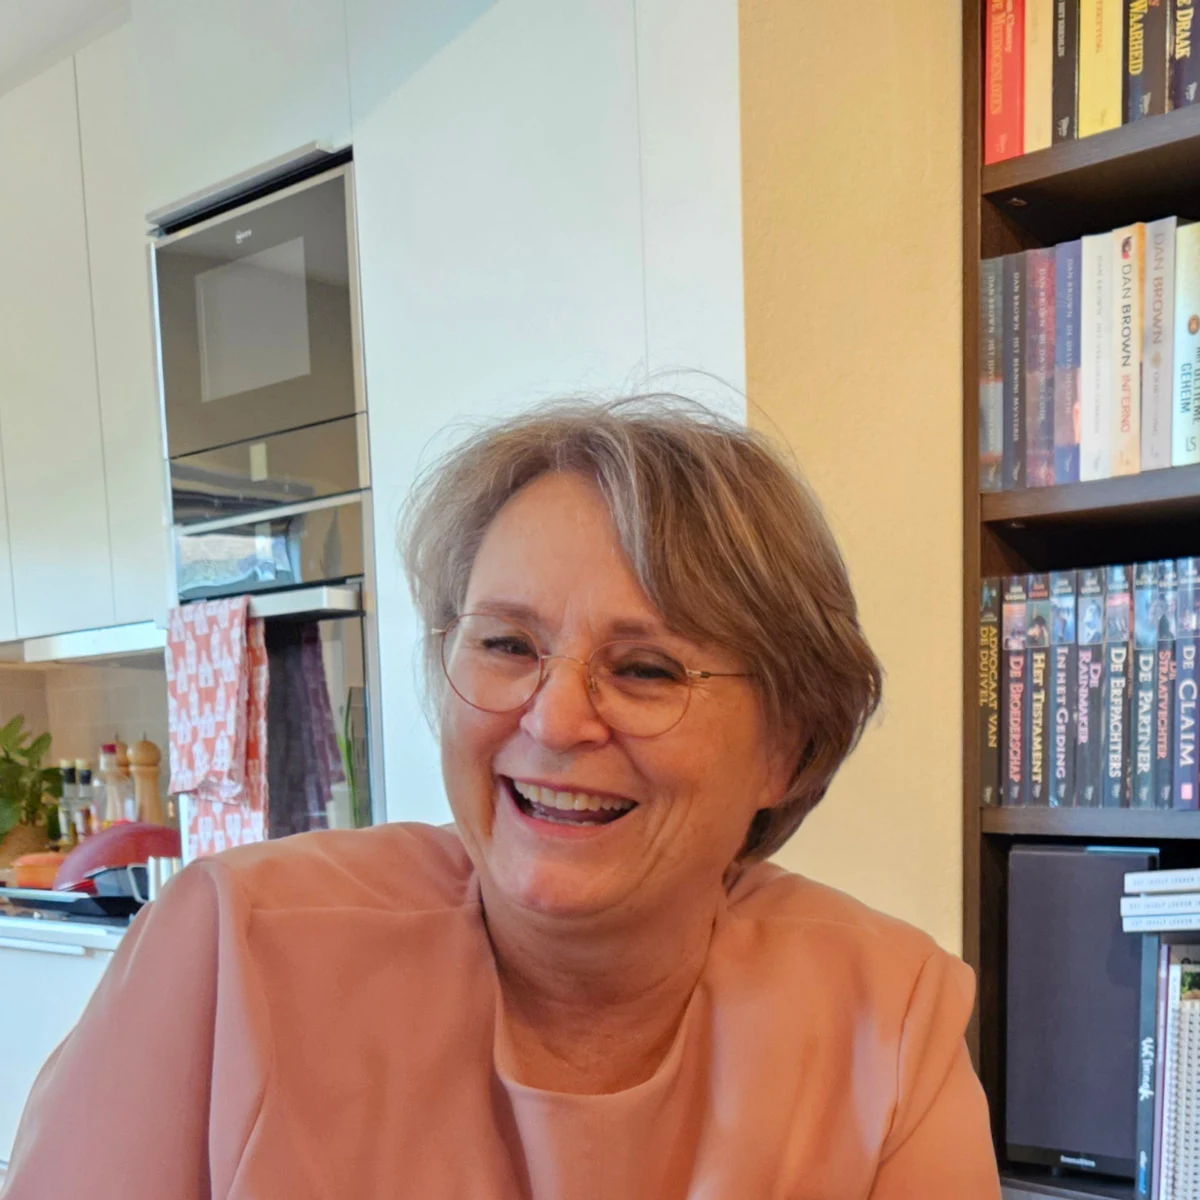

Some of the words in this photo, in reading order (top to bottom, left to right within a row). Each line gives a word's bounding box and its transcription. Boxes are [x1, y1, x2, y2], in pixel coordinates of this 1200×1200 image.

[1128, 0, 1149, 76] WAARHEID
[1175, 8, 1195, 60] DRAAK
[1065, 257, 1074, 280] DAN
[1152, 232, 1166, 271] DAN
[987, 275, 996, 298] DAN
[1012, 271, 1021, 293] DAN
[1039, 268, 1048, 290] DAN
[1119, 263, 1133, 300] DAN
[1012, 295, 1021, 331] BROWN
[1151, 275, 1165, 345] BROWN
[1119, 303, 1134, 368] BROWN
[1118, 373, 1132, 434] INFERNO
[1180, 361, 1193, 415] GEHEIM
[979, 626, 989, 646] DE
[988, 626, 999, 711] ADVOCAAT
[1009, 655, 1025, 678] DE
[1031, 651, 1046, 686] HET
[1056, 647, 1069, 669] IN
[1089, 662, 1102, 688] DE
[1110, 646, 1127, 673] DE
[1138, 652, 1155, 682] DE
[1182, 645, 1196, 670] DE
[979, 649, 988, 707] DUIVEL
[1056, 671, 1068, 706] HET
[1077, 650, 1093, 745] RAINMAKER
[1156, 650, 1171, 759] STRAATVECHTER
[1179, 678, 1198, 767] CLAIM
[988, 714, 999, 748] VAN
[1008, 682, 1025, 783] BROEDERSCHAP
[1031, 690, 1047, 784] TESTAMENT
[1055, 708, 1070, 779] GEDING
[1108, 677, 1126, 779] ERFPACHTERS
[1137, 689, 1154, 775] PARTNER
